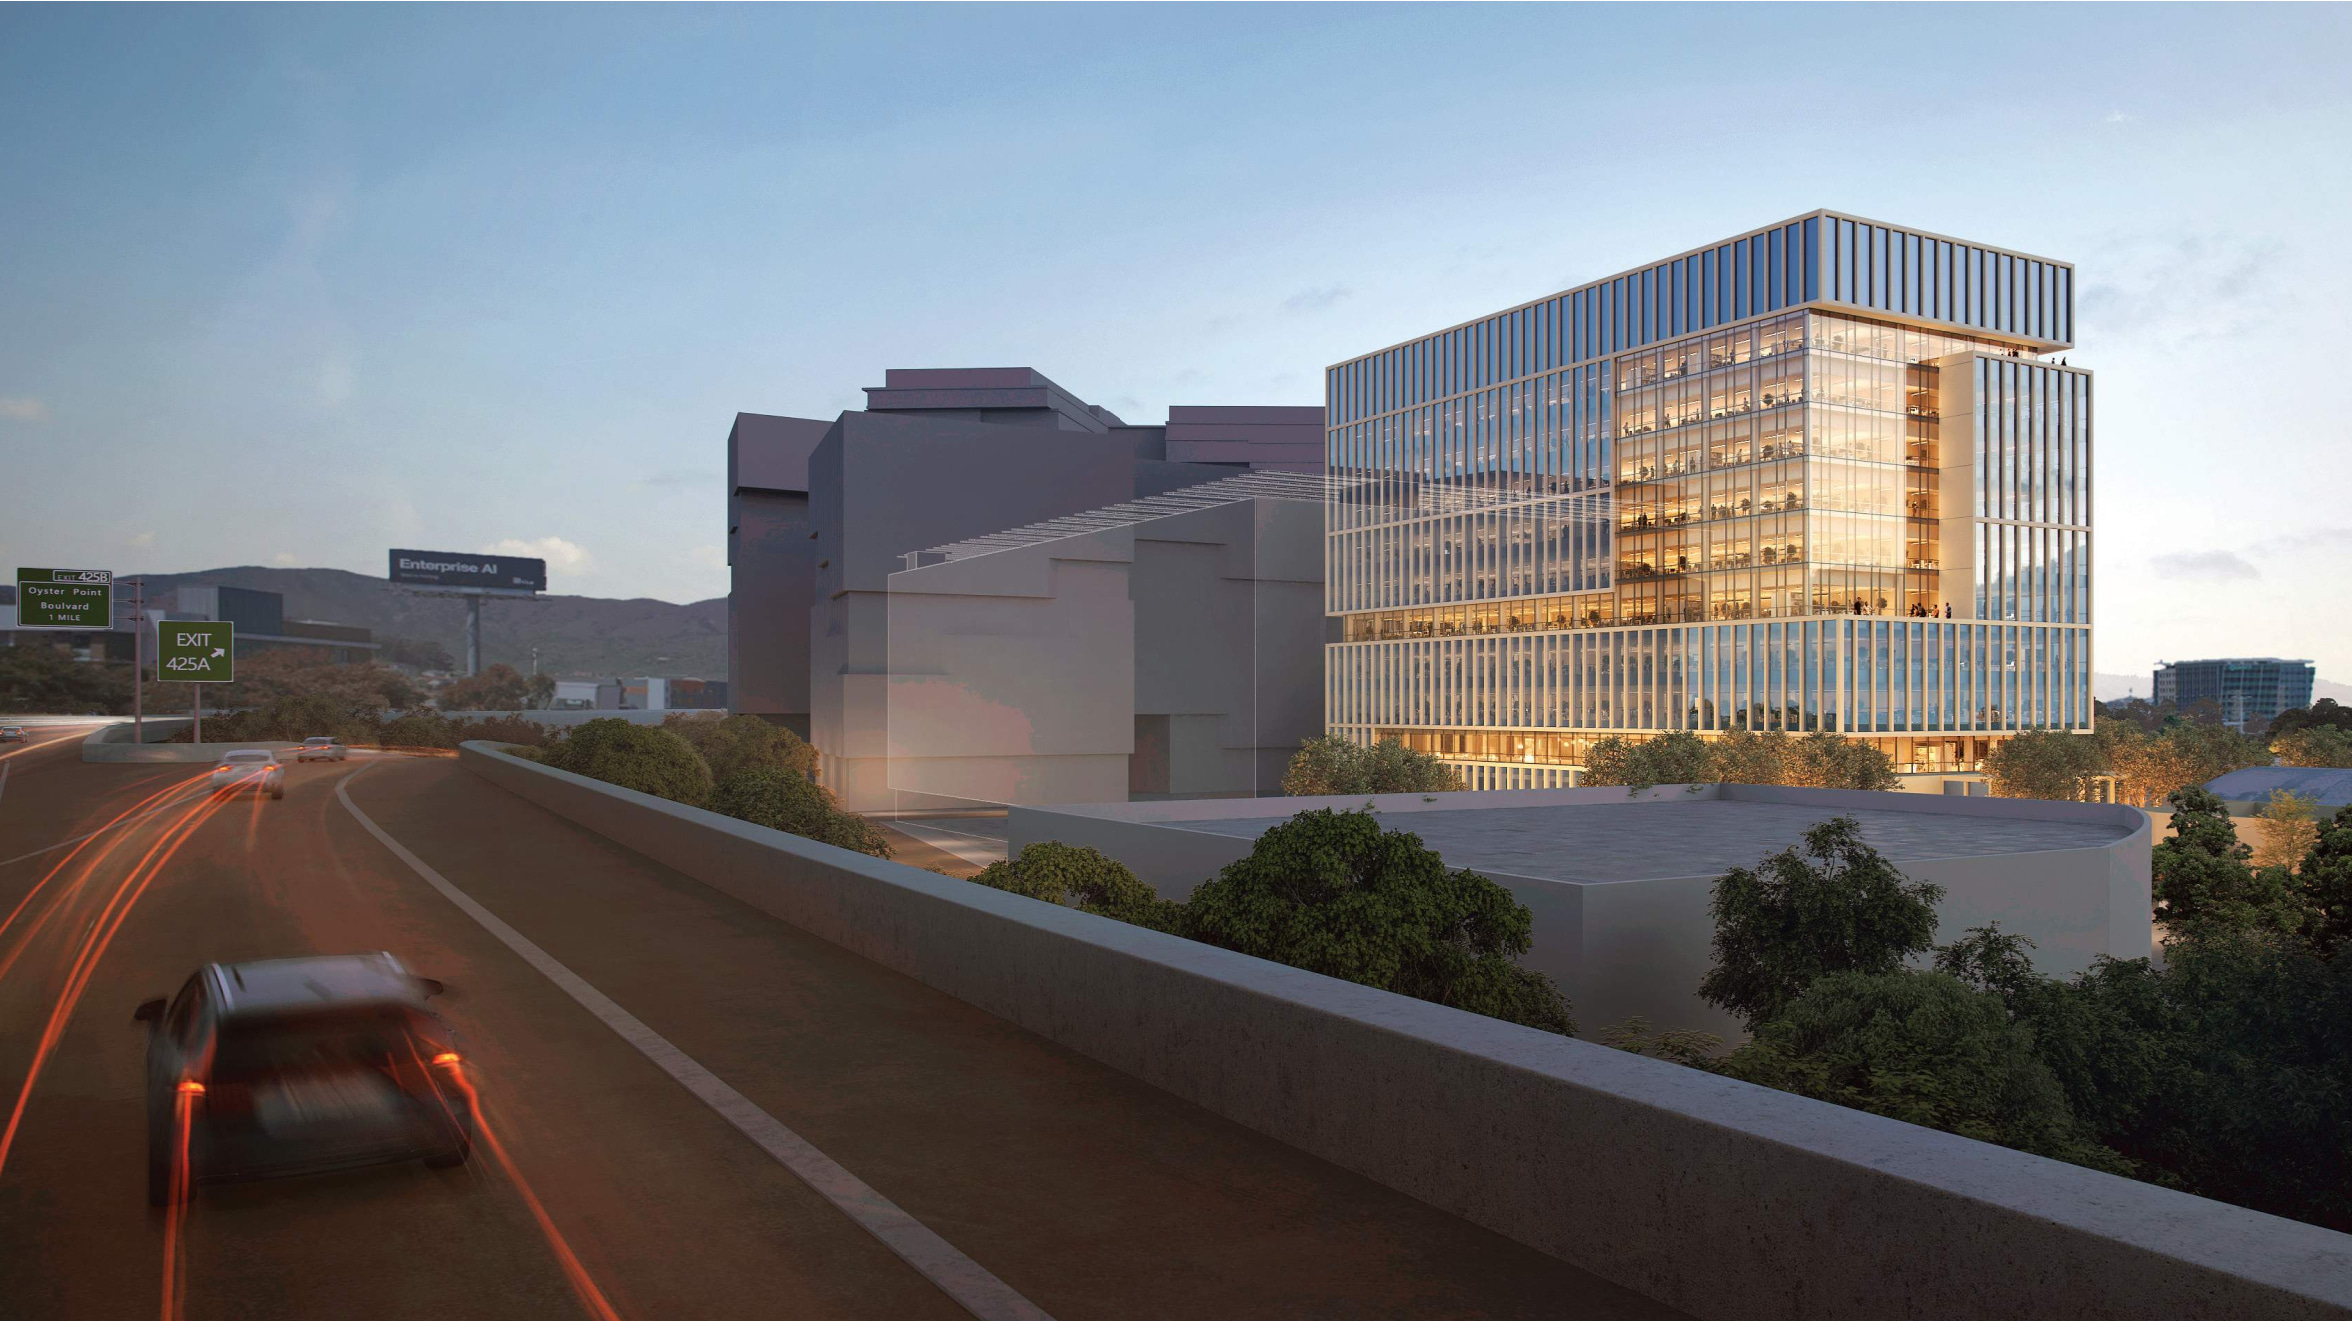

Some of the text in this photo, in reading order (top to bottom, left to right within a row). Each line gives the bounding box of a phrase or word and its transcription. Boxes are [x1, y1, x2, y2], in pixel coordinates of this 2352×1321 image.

[400, 558, 497, 574] Enterprise AI
[78, 572, 108, 582] 425B
[28, 586, 102, 596] Oyster Point
[40, 602, 89, 610] Boulvard
[176, 632, 213, 647] EXIT
[165, 656, 211, 671] 425A
